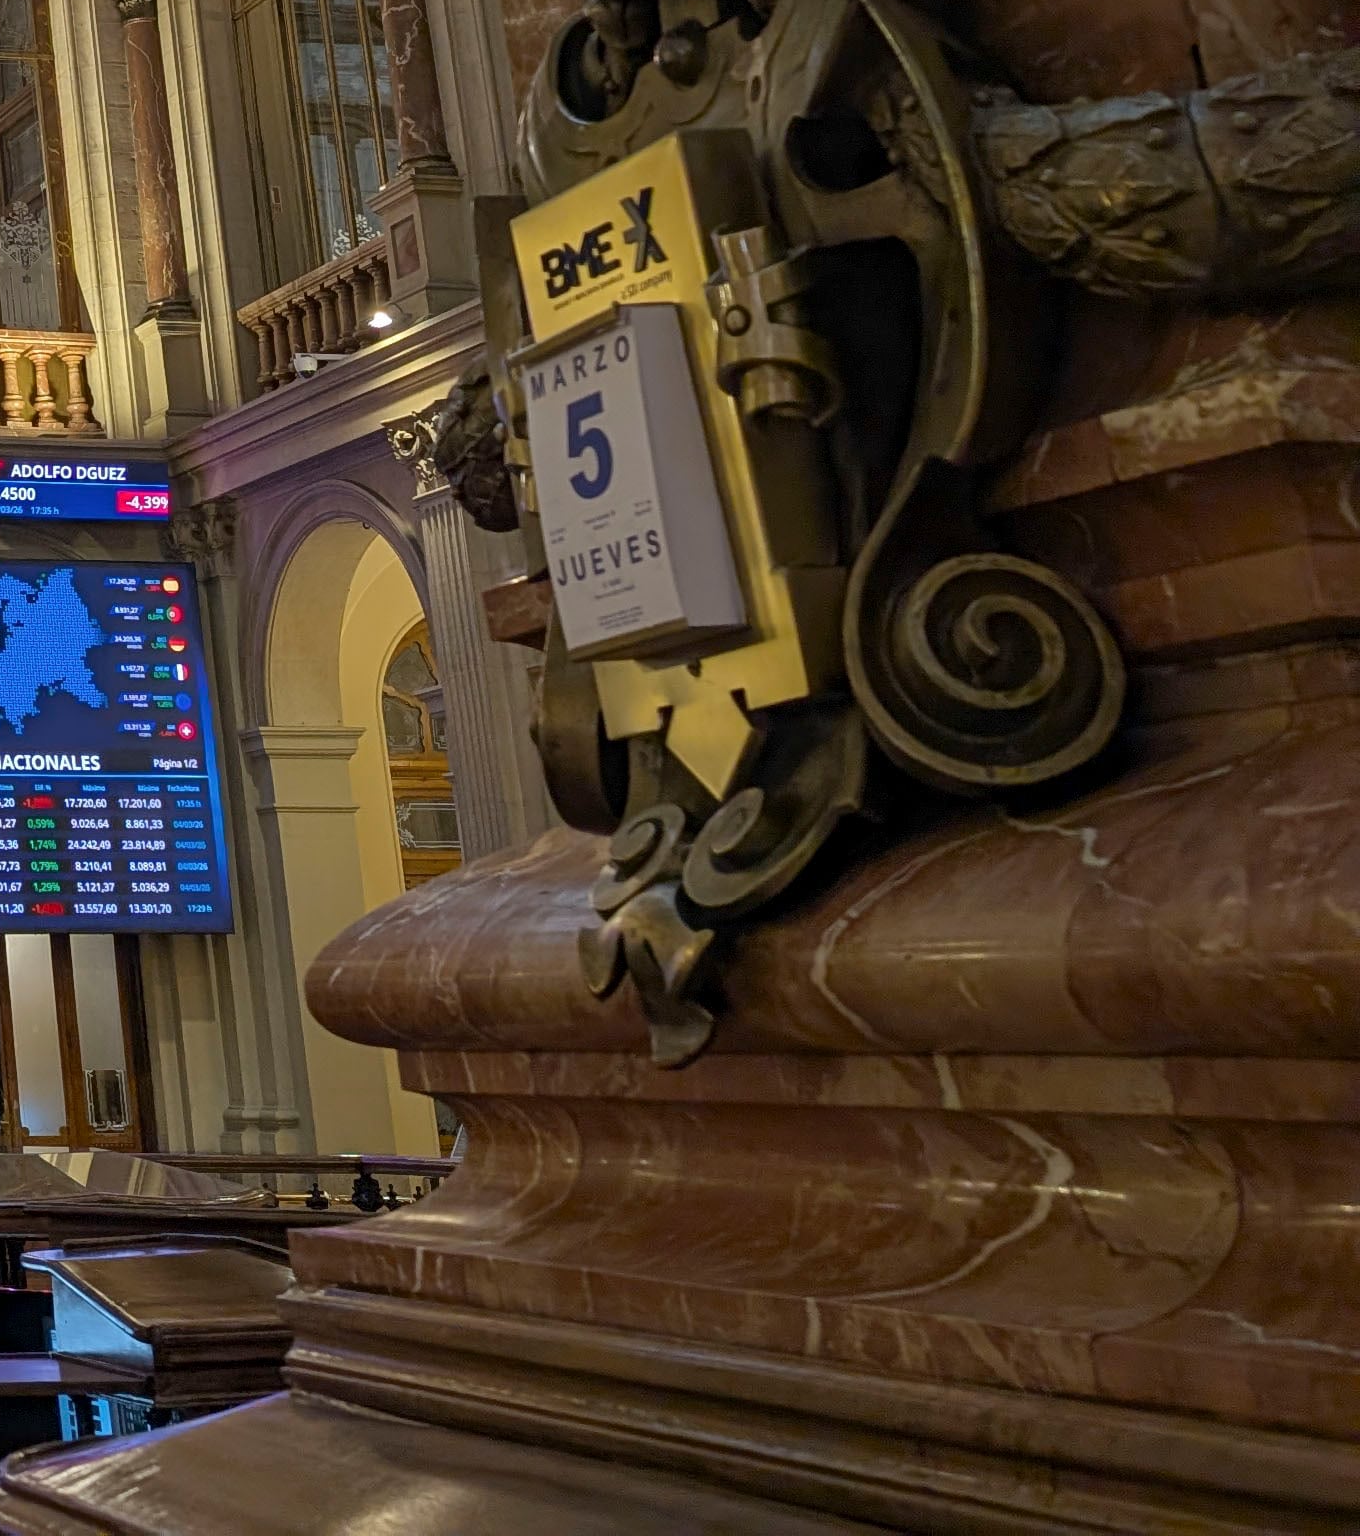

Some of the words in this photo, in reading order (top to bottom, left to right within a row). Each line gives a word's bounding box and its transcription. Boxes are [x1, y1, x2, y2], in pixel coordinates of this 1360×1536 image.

[530, 335, 630, 400] MARZO
[9, 464, 72, 482] ADOLFO
[77, 467, 125, 480] DGUEZ
[567, 390, 613, 499] 5
[557, 529, 662, 587] JUEVES
[154, 759, 182, 770] Página
[180, 759, 197, 768] 1/2
